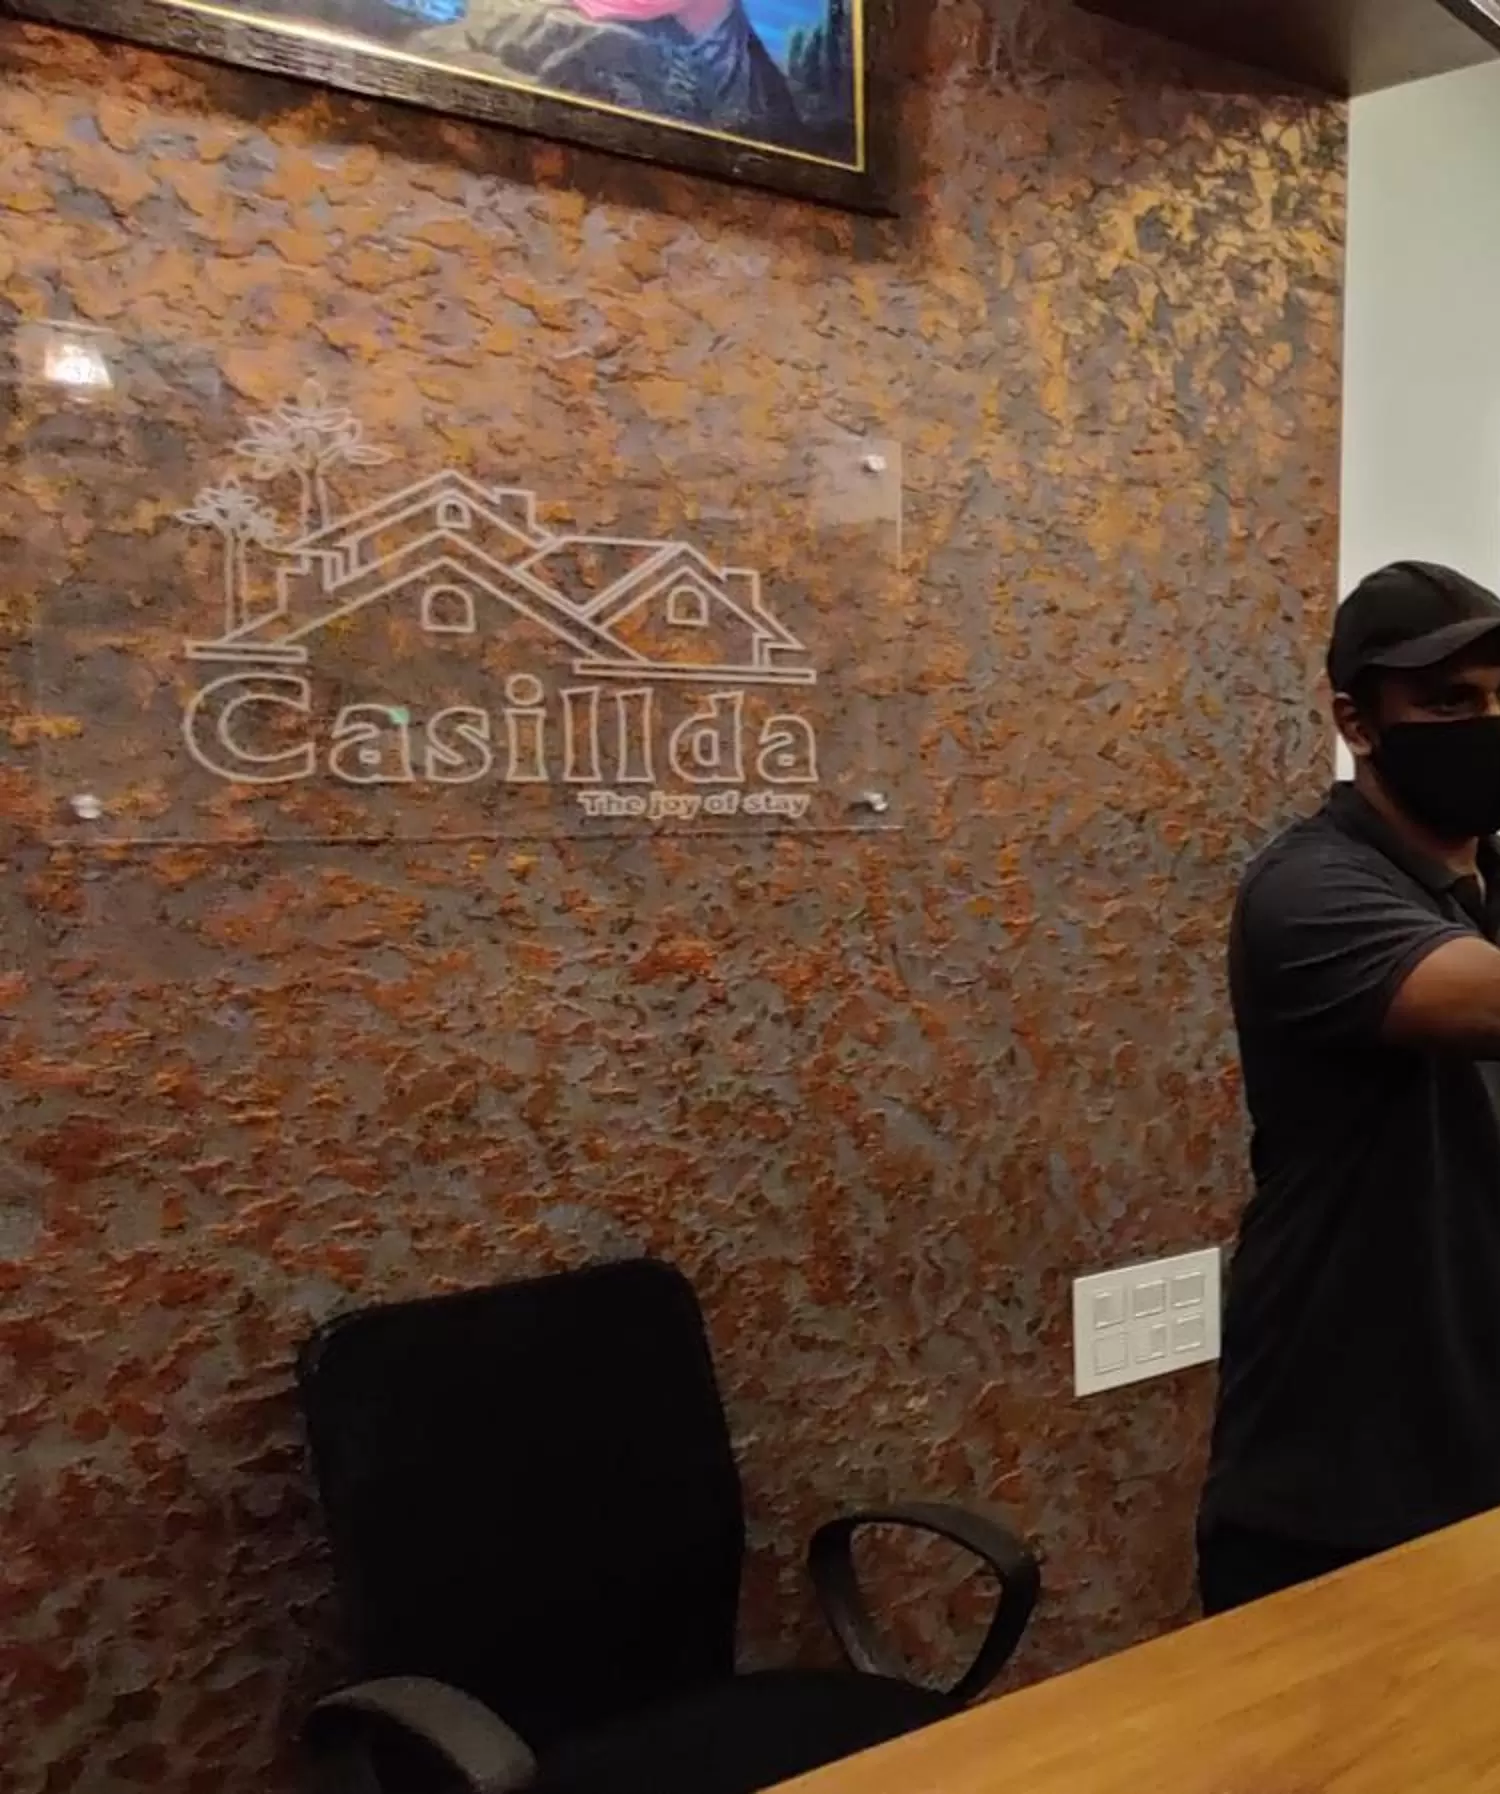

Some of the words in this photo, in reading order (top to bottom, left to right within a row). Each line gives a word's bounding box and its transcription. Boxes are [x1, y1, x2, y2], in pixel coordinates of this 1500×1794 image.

[180, 671, 819, 784] Casillda
[577, 790, 646, 816] The
[647, 790, 701, 820] joy
[703, 789, 741, 815] of
[742, 789, 811, 819] stay
